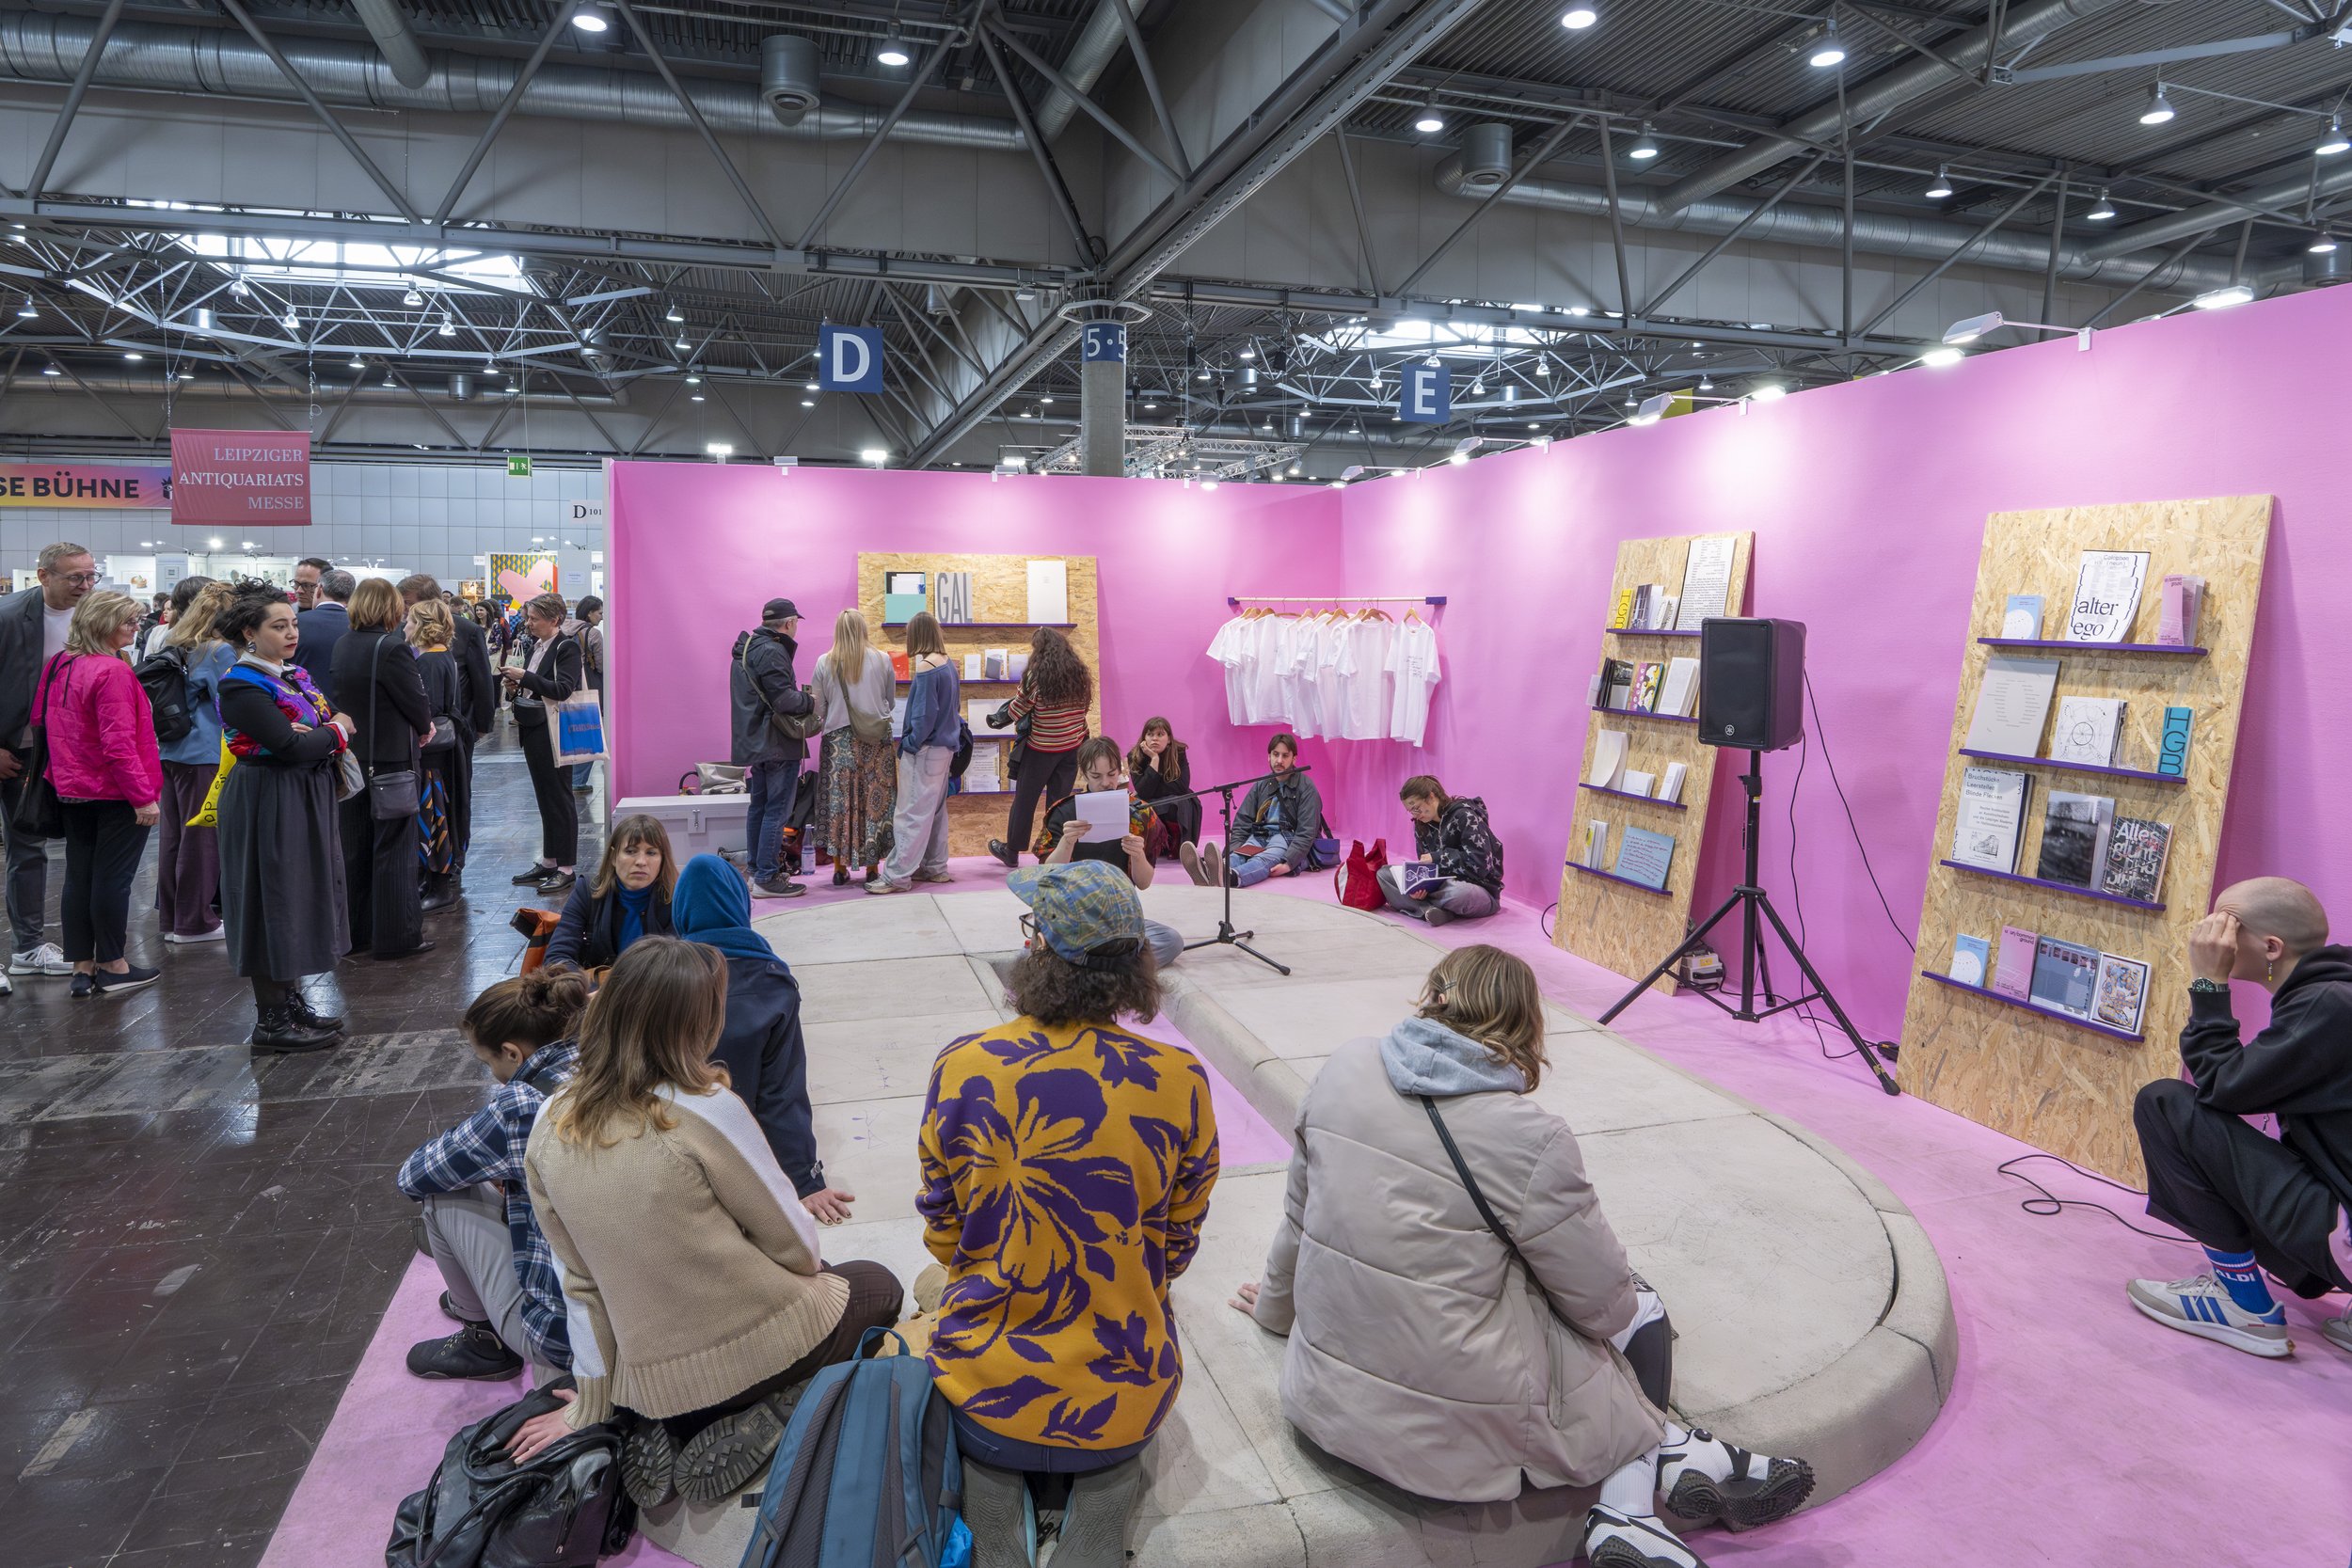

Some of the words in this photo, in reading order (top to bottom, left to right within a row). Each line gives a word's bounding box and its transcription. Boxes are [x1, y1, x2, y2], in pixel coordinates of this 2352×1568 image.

[833, 332, 870, 383] D
[1414, 370, 1437, 415] E
[215, 448, 304, 462] LEIPZIGER
[33, 470, 139, 499] BÜHNE
[179, 471, 304, 489] ANTIQUARIATS
[247, 496, 304, 510] MESSE
[573, 504, 587, 518] D
[937, 572, 973, 624] GAL
[2077, 596, 2119, 615] alter
[2073, 622, 2105, 641] ego
[2115, 822, 2160, 843] Alles
[2216, 1269, 2256, 1282] ALDI
